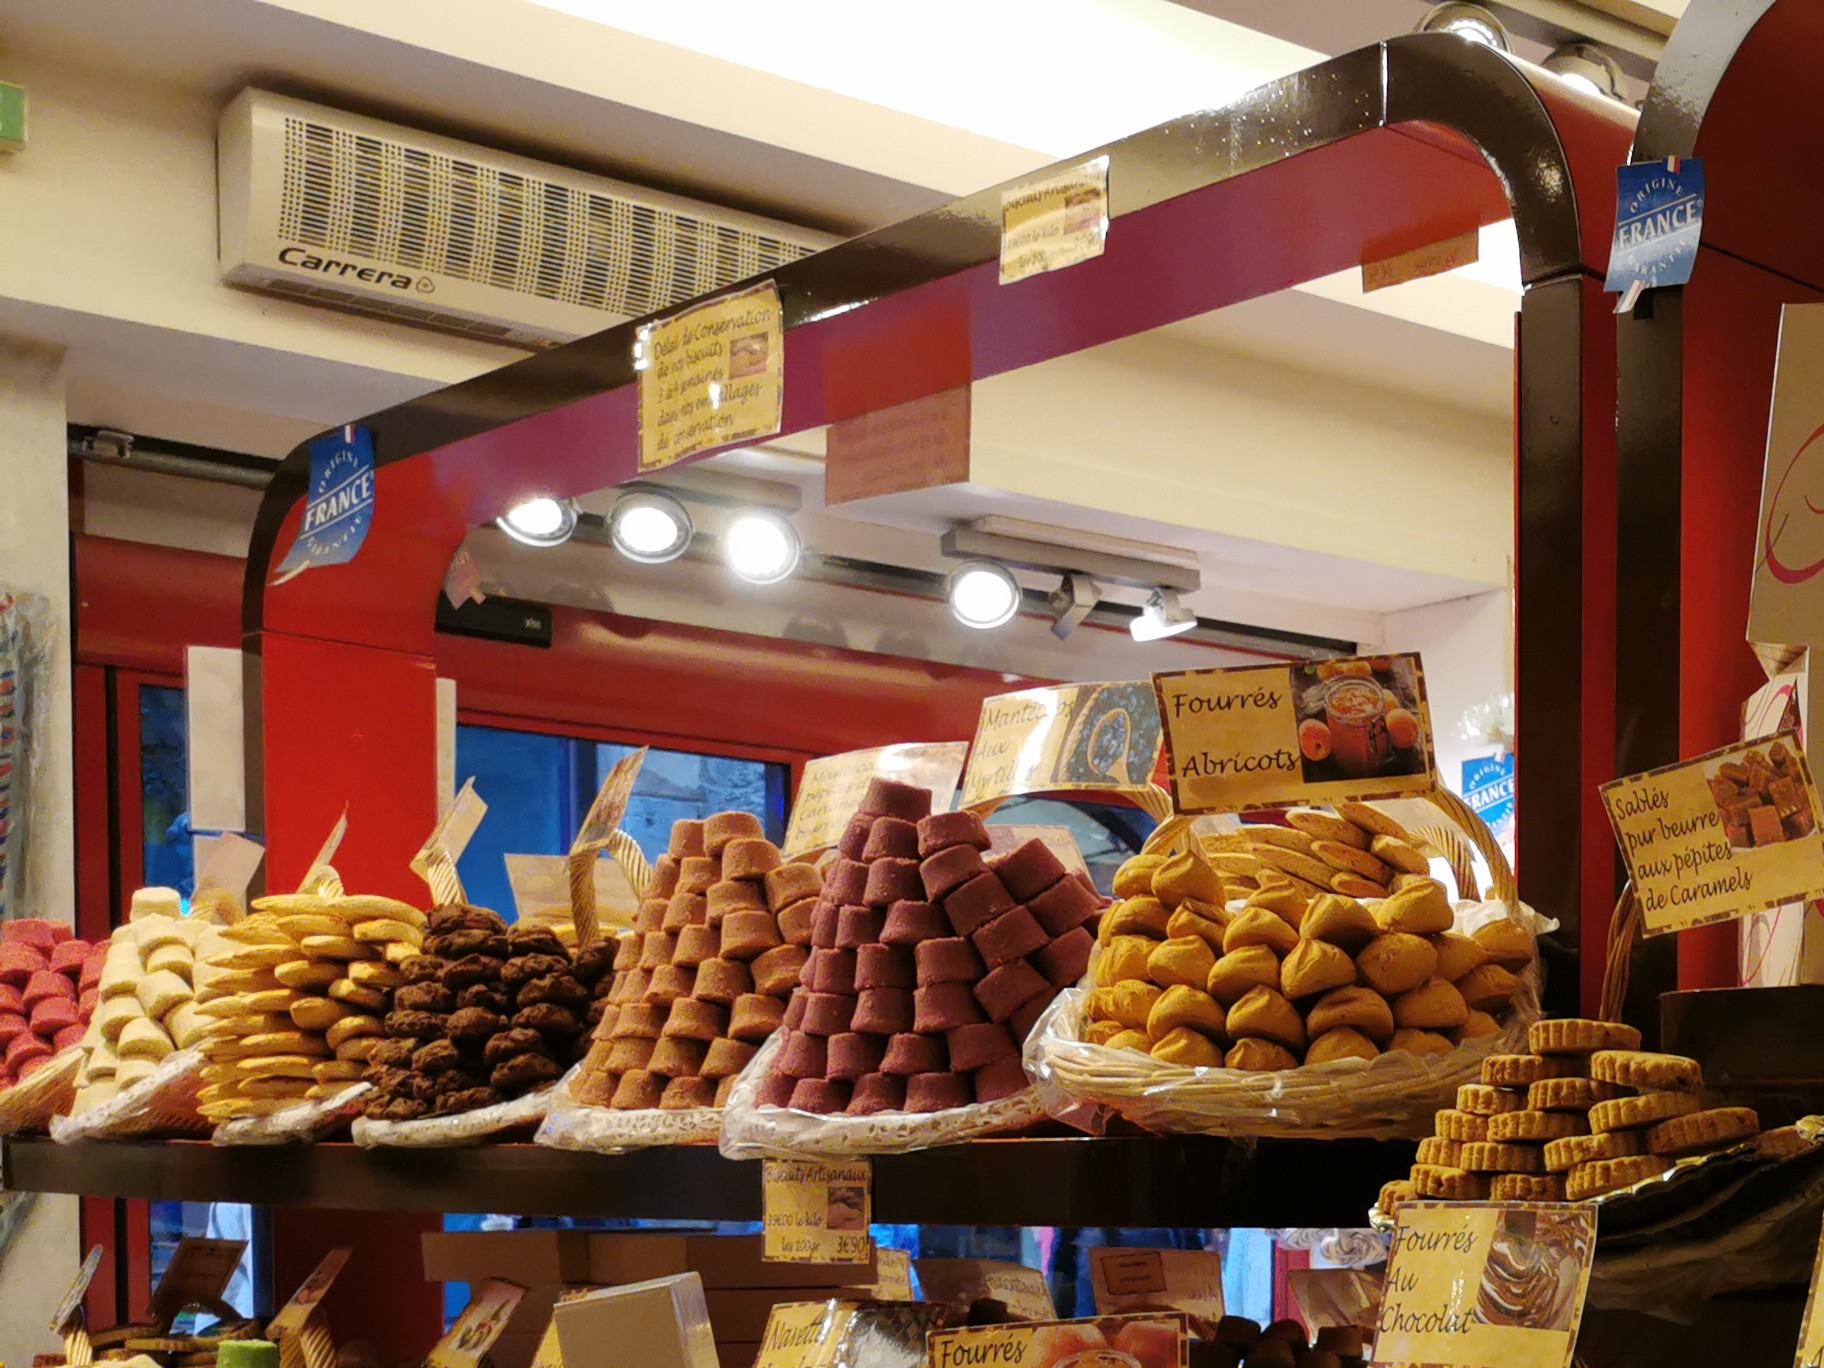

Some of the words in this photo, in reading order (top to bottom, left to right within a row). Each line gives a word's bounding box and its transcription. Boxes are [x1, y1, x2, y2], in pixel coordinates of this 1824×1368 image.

[1630, 178, 1684, 214] ORIGINE
[1618, 199, 1697, 250] FRANCE
[278, 247, 413, 290] Carrera
[694, 307, 771, 340] Conservation
[304, 471, 373, 532] FRANCE
[1171, 686, 1283, 719] Fourrés
[1181, 748, 1301, 778] Abricots
[1614, 785, 1670, 822] Sablés
[1625, 828, 1657, 858] pur
[1656, 809, 1720, 842] beurre
[1637, 858, 1673, 881] aux
[1673, 840, 1733, 879] pépites
[1645, 887, 1669, 913] de
[1668, 865, 1754, 907] Caramels
[1393, 1224, 1480, 1257] Fourrés
[1386, 1266, 1421, 1293] Au
[1378, 1302, 1474, 1335] Chocolat
